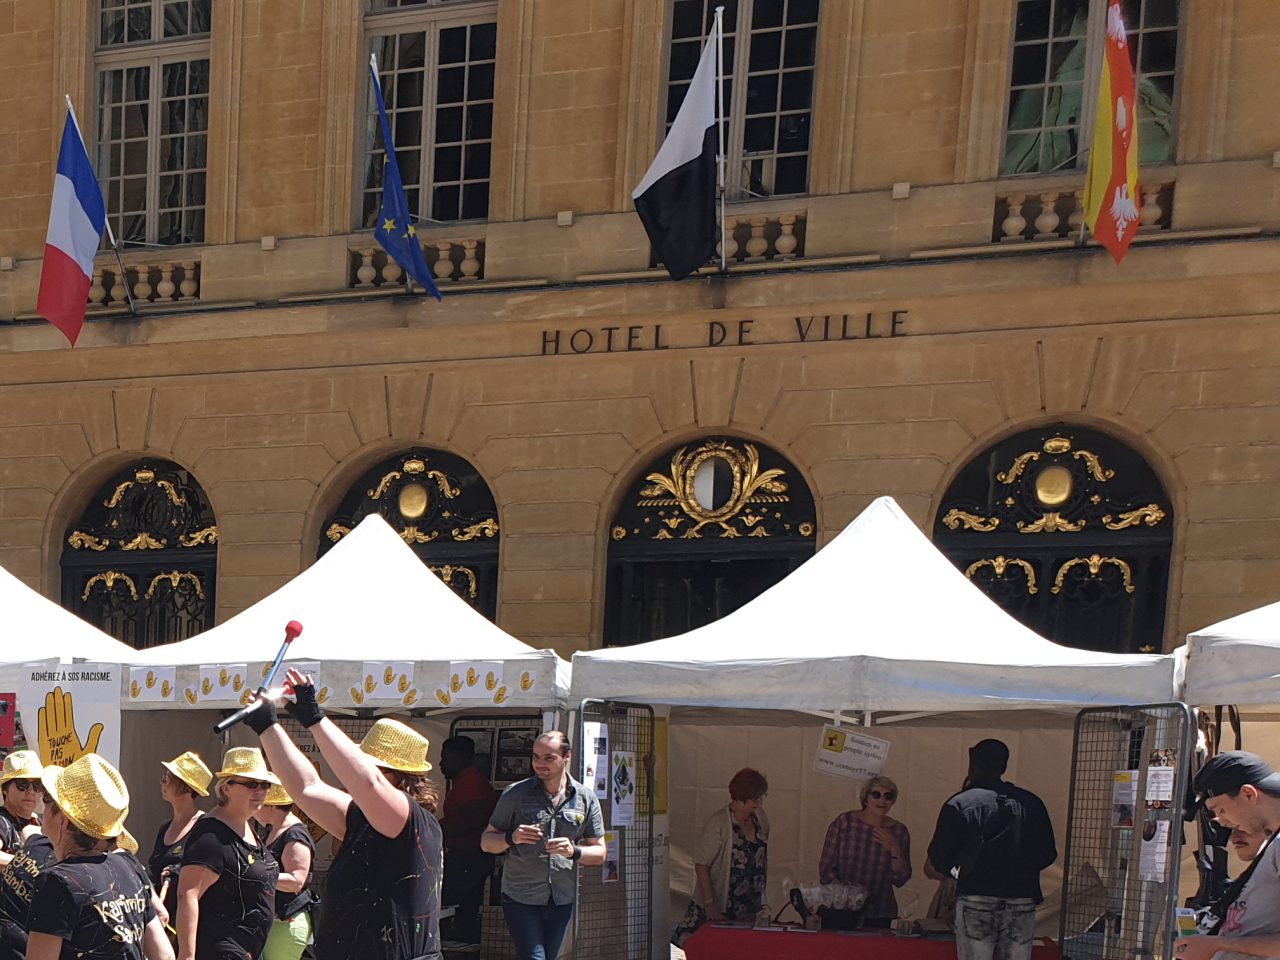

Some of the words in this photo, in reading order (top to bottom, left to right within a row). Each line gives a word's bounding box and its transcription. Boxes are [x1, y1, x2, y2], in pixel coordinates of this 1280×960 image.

[541, 325, 669, 355] HOTEL
[707, 320, 754, 347] DE
[794, 310, 909, 342] VILLE
[31, 670, 60, 681] ADHÉREZ
[61, 670, 67, 681] À
[68, 672, 79, 681] SOS
[48, 732, 72, 747] TOUCHE
[51, 748, 63, 760] PAS
[94, 894, 146, 923] Karimb
